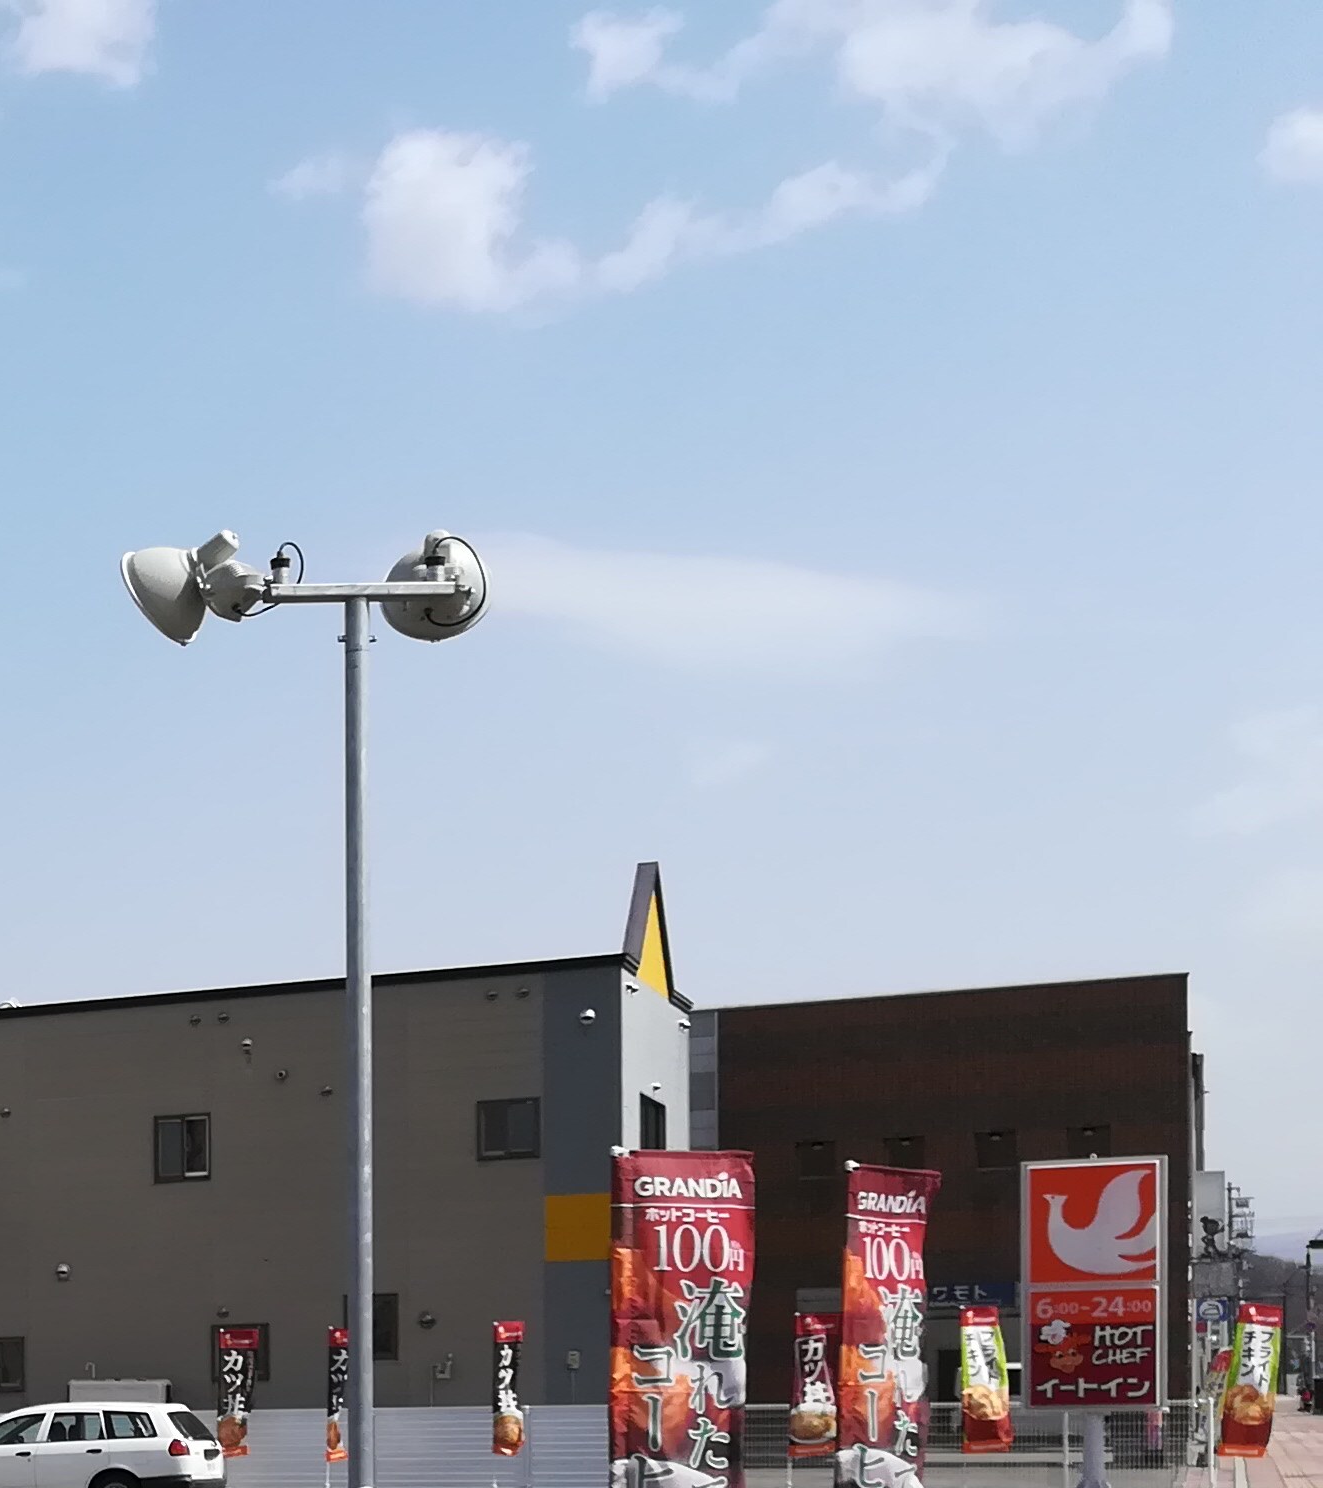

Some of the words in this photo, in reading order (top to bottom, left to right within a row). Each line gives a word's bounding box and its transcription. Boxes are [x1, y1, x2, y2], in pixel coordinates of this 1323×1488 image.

[645, 1207, 731, 1223] ホットコーヒー
[1093, 1325, 1154, 1347] HOT
[1091, 1347, 1152, 1365] CHEF
[1240, 1331, 1256, 1377] チキン
[222, 1350, 246, 1414] カツ丼
[801, 1340, 830, 1405] カツ丼
[1036, 1378, 1151, 1398] イートイン
